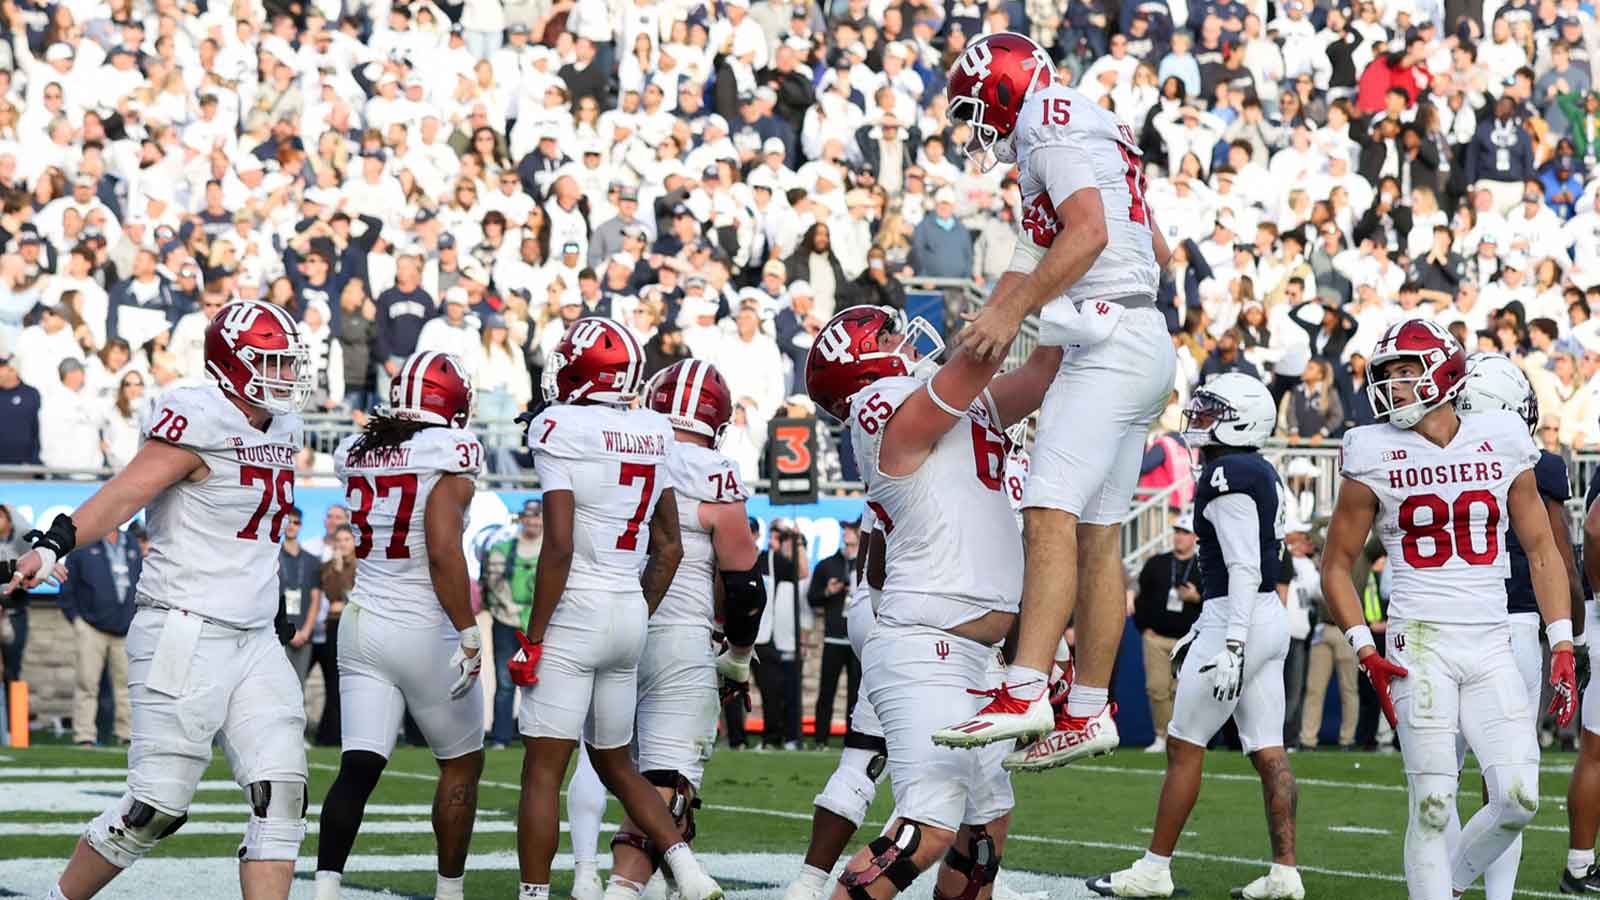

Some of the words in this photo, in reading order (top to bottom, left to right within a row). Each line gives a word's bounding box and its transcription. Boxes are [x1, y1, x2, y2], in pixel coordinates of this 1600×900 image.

[1041, 99, 1071, 126] 15
[152, 407, 188, 442] 78
[857, 393, 893, 435] 65
[539, 419, 557, 444] 7
[602, 431, 654, 455] WILLIAMS
[455, 442, 480, 468] 37
[776, 427, 811, 473] 3
[708, 470, 740, 500] 74
[1209, 466, 1230, 492] 4
[1389, 461, 1503, 489] HOOSIERS
[236, 465, 295, 543] 78
[345, 473, 417, 560] 37
[616, 462, 656, 551] 7
[1398, 489, 1501, 569] 80
